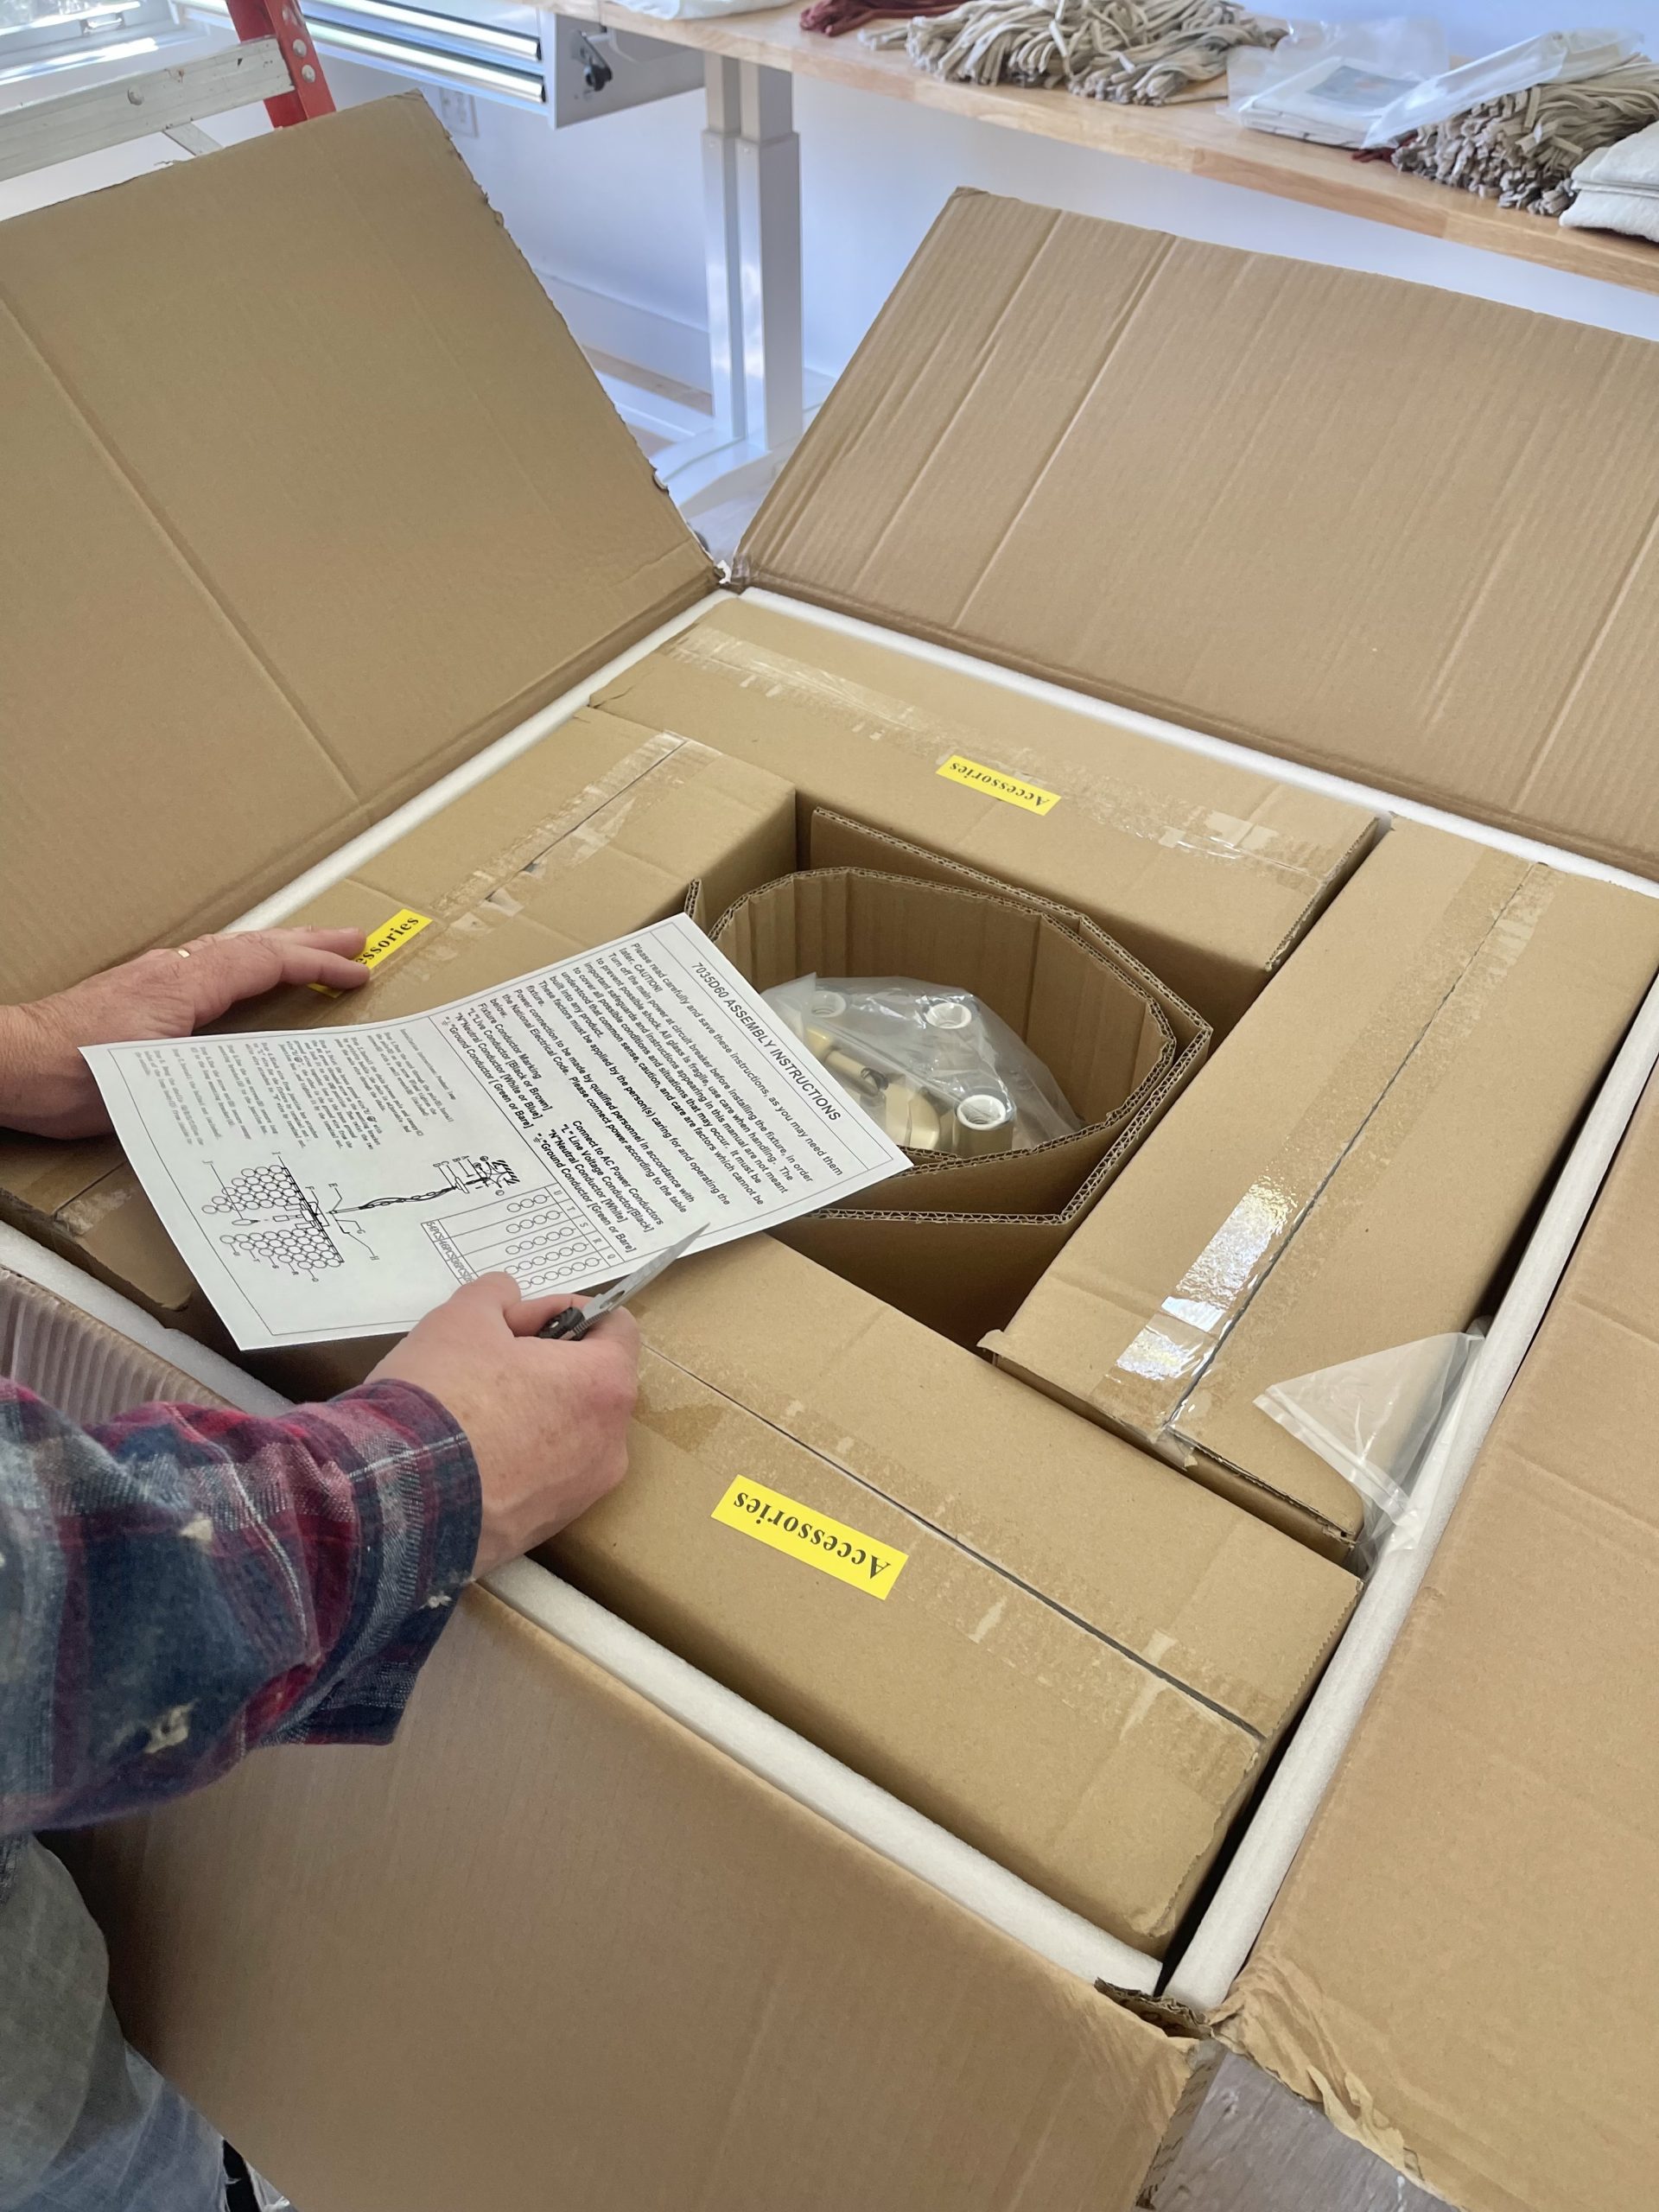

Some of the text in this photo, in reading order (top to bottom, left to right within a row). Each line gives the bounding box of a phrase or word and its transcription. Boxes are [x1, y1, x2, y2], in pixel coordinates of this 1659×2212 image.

[950, 762, 1050, 806] Accessories
[355, 918, 419, 964] essories
[572, 966, 582, 975] to
[578, 974, 596, 990] cover
[549, 975, 565, 990] built
[560, 988, 574, 1002] into
[569, 1001, 584, 1014] any
[592, 990, 605, 999] all
[596, 998, 624, 1024] possible
[477, 1002, 542, 1080] Fixture Conductor Marking
[477, 1042, 505, 1074] Conductor
[482, 1029, 512, 1060] Conductor
[522, 1079, 533, 1088] or
[620, 1022, 651, 1055] conditions
[630, 942, 843, 1176] Please read carefully and save these instructions, as you may need them
[691, 962, 842, 1121] 7035D60 ASSEMBLY INSTRUCTIONS
[583, 961, 789, 1194] important safeguards and instructions appearing in this manual are not meant
[595, 957, 793, 1181] to prevent possible shock. All glass is fragile, use care when handling. The
[607, 951, 813, 1182] Turn off the main power at circuit breaker before installing the fixture, in order
[647, 1054, 664, 1068] and
[501, 993, 513, 1005] the
[510, 1003, 536, 1029] National
[529, 1027, 558, 1057] Electrical
[568, 1076, 589, 1098] Please
[586, 1097, 613, 1124] connect
[605, 1123, 628, 1144] power
[624, 1144, 656, 1178] according
[652, 1176, 662, 1185] to
[658, 1185, 672, 1197] the
[668, 1195, 687, 1213] table
[513, 988, 695, 1203] Power connection to be made by qualified personnel in accordance with
[537, 979, 730, 1205] These factors must be applied by the person(s) caring for and operating the
[560, 971, 764, 1205] understood that common sense, caution, and care are factors which cannot be
[658, 1066, 689, 1099] situations
[684, 1097, 702, 1113] that
[696, 1112, 713, 1128] may
[568, 1135, 583, 1151] Line
[581, 1149, 604, 1176] Voltage
[709, 1127, 730, 1149] occur.
[572, 1120, 664, 1225] Connect to AC Power Conductors
[574, 1163, 607, 1198] Conductor
[734, 1155, 755, 1174] must
[749, 1173, 762, 1184] be
[734, 1492, 891, 1579] Accessories
